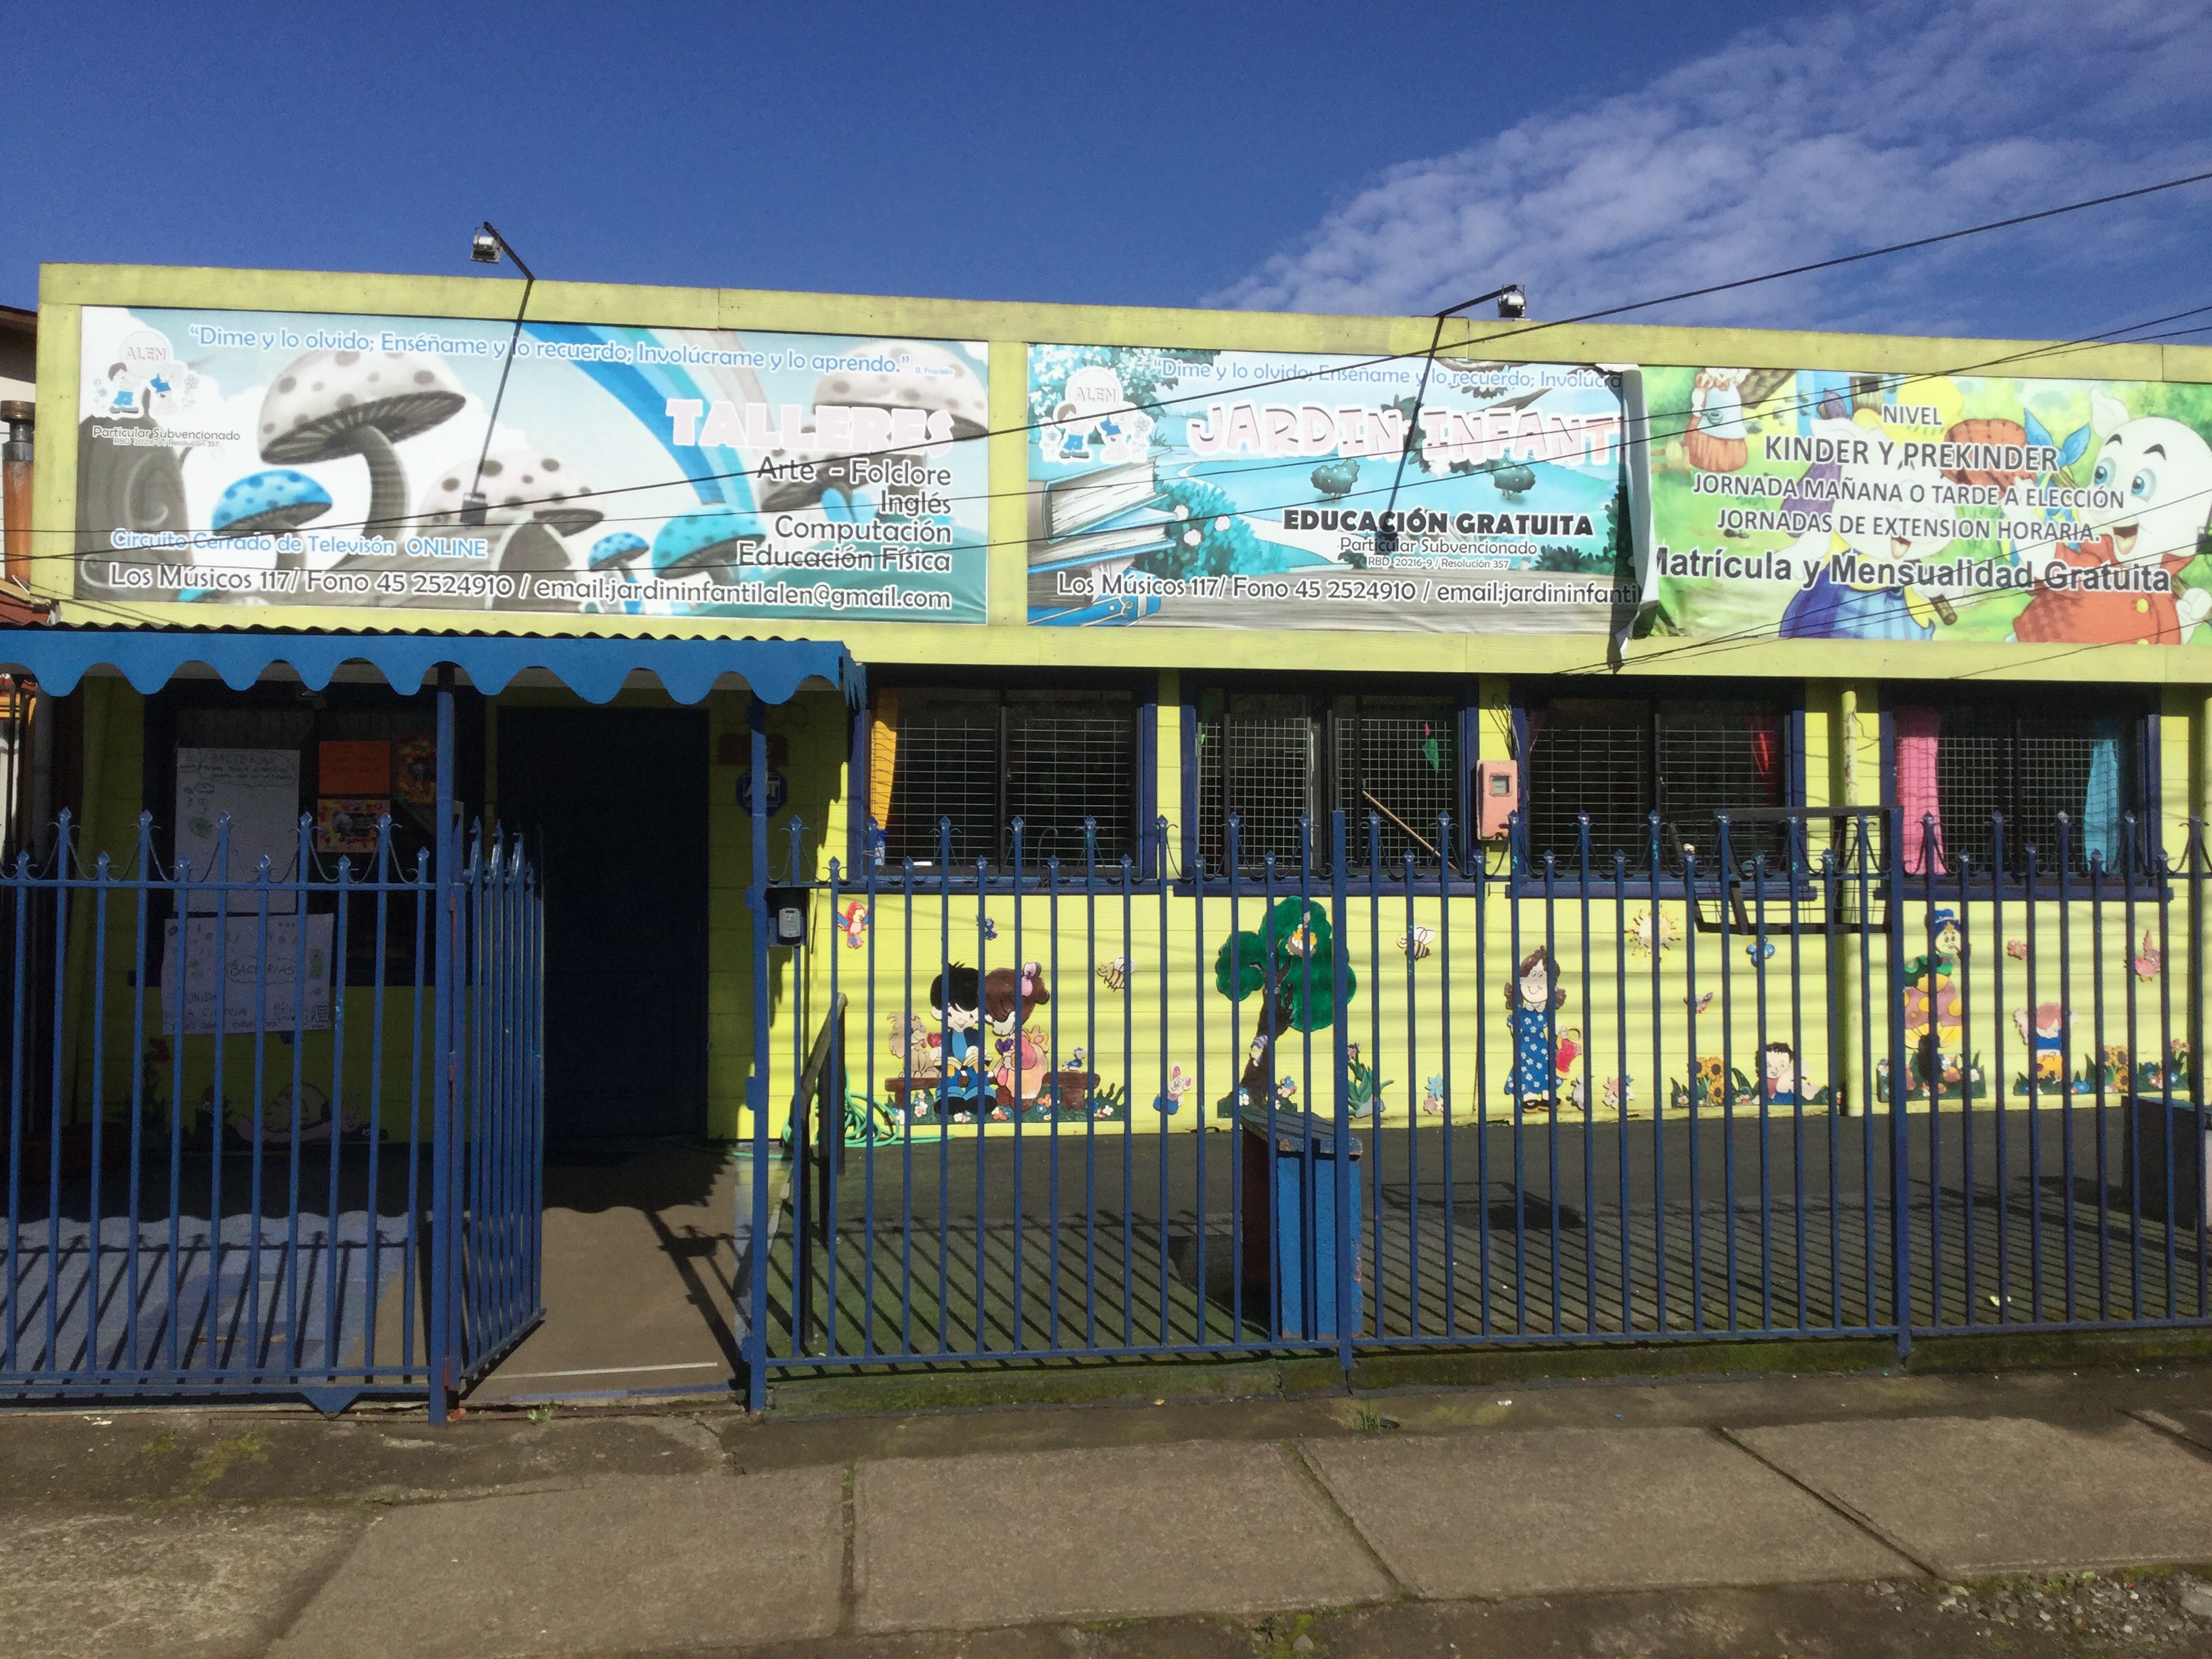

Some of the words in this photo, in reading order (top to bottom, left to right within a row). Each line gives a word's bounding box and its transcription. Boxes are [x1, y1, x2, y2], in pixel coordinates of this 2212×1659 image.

[127, 346, 166, 361] ALEN
[262, 332, 274, 350] y
[281, 329, 298, 348] lo
[307, 330, 374, 351] olvido;
[382, 332, 487, 354] Enséñame
[494, 342, 505, 358] y
[537, 342, 632, 363] recuerdo;
[638, 344, 764, 368] Involúcrame
[771, 354, 783, 373] y
[789, 350, 805, 369] lo
[1217, 367, 1226, 380] y
[1233, 363, 1247, 378] lo
[1254, 364, 1312, 382] olvido;
[1433, 368, 1447, 384] lo
[1453, 370, 1534, 386] recuerdo;
[1076, 387, 1116, 402] ALEN
[666, 398, 954, 457] TALLERES
[1883, 405, 1942, 426] NIVEL
[94, 428, 150, 437] Particular
[153, 429, 240, 440] Subvencionado
[1191, 405, 1405, 455] JARDIN
[1765, 436, 1868, 466] KINDER
[1878, 442, 1894, 465] Y
[1904, 444, 2057, 470] PREKINDER
[758, 456, 814, 480] Arte
[851, 461, 951, 485] Folclore
[881, 491, 950, 515] Inglés
[1694, 474, 1796, 497] JORNADA
[1804, 475, 1900, 501] MAÑANA
[1910, 484, 1925, 504] O
[1932, 484, 1997, 506] TARDE
[2005, 486, 2019, 506] A
[2027, 484, 2124, 508] ELECCIÓN
[775, 514, 951, 543] Computación
[1284, 508, 1448, 533] EDUCACIÓN
[1456, 513, 1593, 535] GRATUITA
[1717, 510, 1832, 533] JORNADAS
[1840, 516, 1865, 535] DE
[1874, 518, 1990, 539] EXTENSION
[1998, 522, 2100, 541] HORARIA.
[112, 530, 186, 548] Circuito
[194, 533, 271, 551] Cerrado
[279, 535, 301, 552] de
[407, 538, 487, 557] ONLINE
[739, 543, 872, 569] Educación
[882, 547, 950, 571] Física
[1341, 538, 1416, 552] Particular
[1422, 539, 1536, 554] Subvencionado
[1368, 557, 1389, 566] RBD
[1442, 559, 1490, 568] Resolución
[1805, 560, 1820, 587] y
[1831, 555, 2033, 588] Mensualidad
[2045, 562, 2170, 591] Gratuita
[112, 566, 151, 586] Los
[159, 566, 251, 589] Músicos
[308, 571, 367, 591] Fono
[377, 573, 405, 592] 45
[412, 575, 512, 597] 2524910
[1059, 574, 1093, 594] Los
[1103, 575, 1184, 594] Músicos
[1234, 579, 1288, 596] Fono
[1296, 581, 1320, 598] 45
[1328, 581, 1416, 599] 2524910
